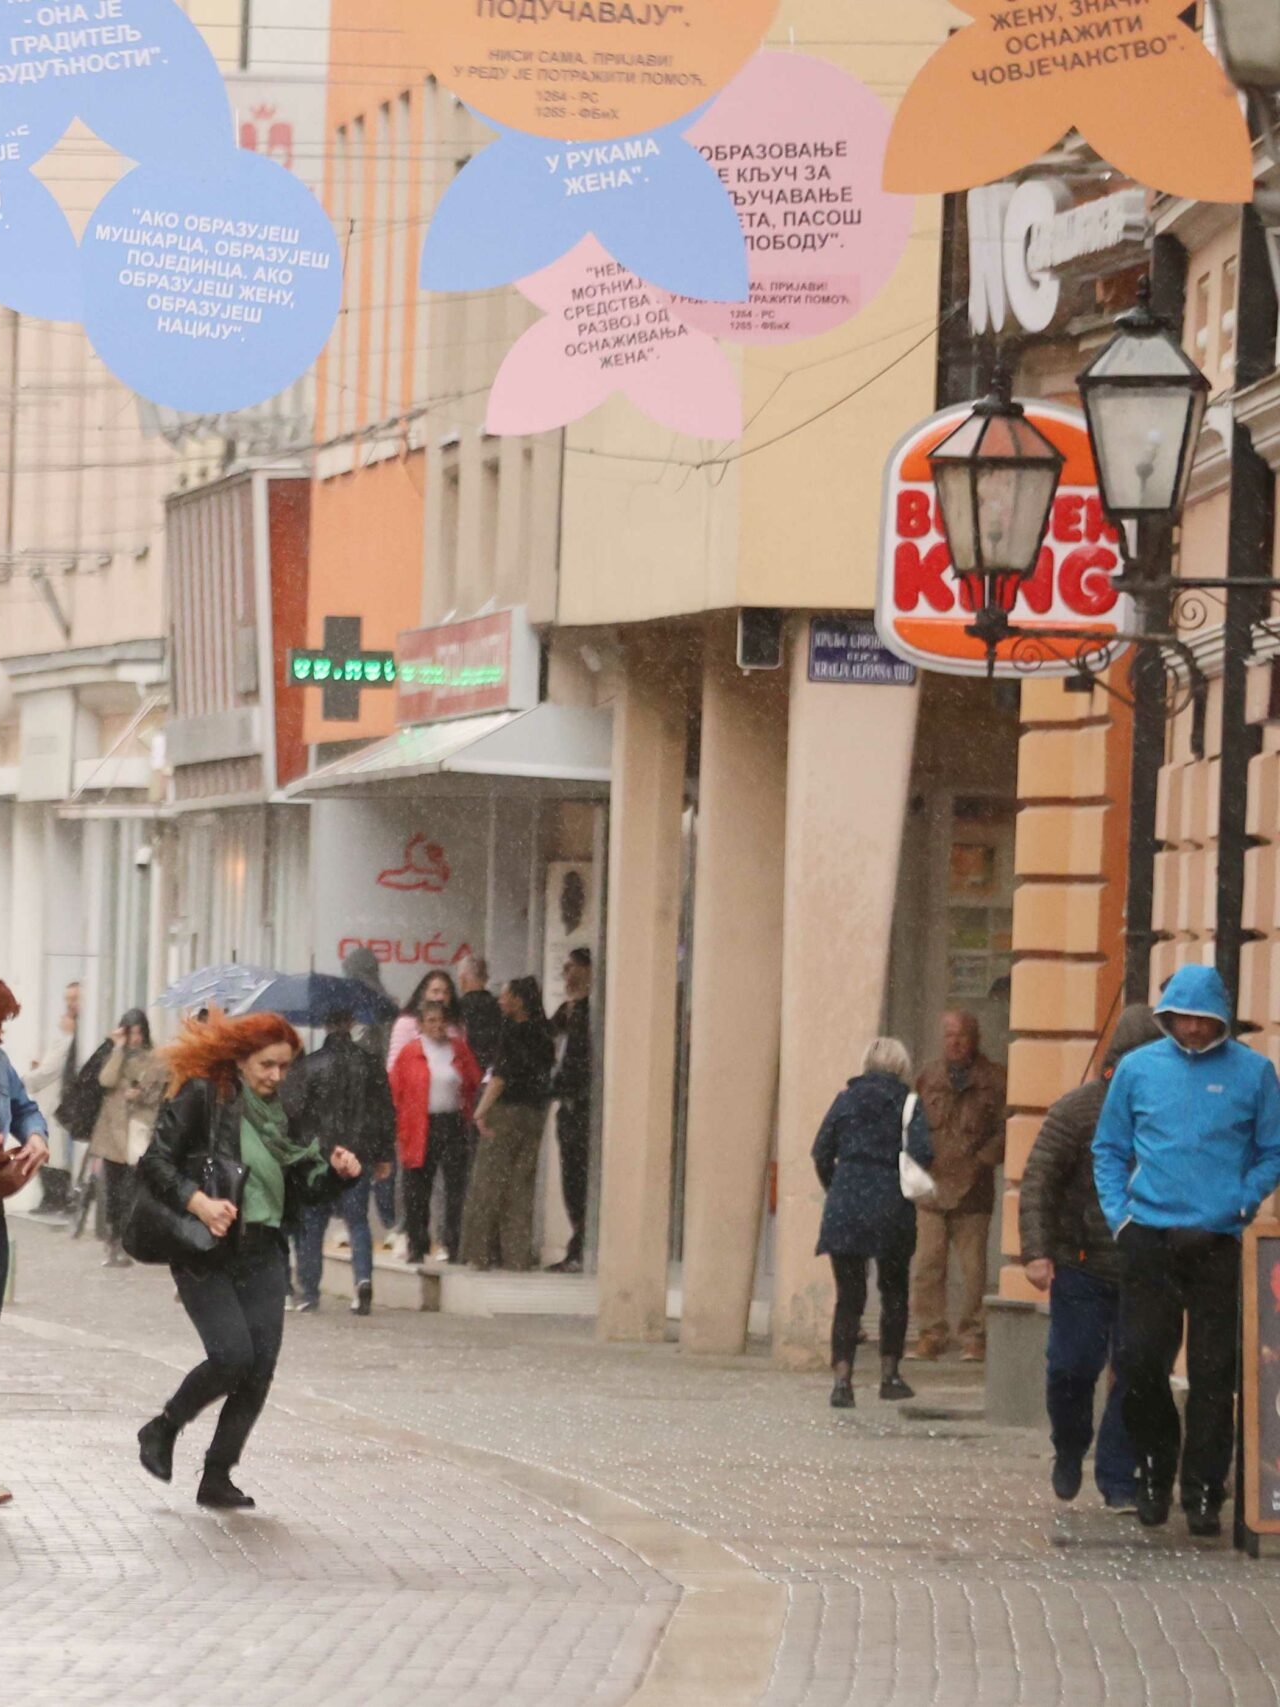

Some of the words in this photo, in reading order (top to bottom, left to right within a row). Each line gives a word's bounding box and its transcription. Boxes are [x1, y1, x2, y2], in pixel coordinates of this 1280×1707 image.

[36, 4, 89, 27] ОНА
[94, 0, 123, 20] ЈЕ
[990, 4, 1063, 32] ЖЕНУ,
[10, 24, 142, 56] ГРАДИТЕЉ
[1005, 15, 1143, 55] ОСНАЖИТИ
[545, 154, 560, 174] У
[565, 137, 660, 171] РУКАМА
[737, 166, 798, 183] КЉУЧ
[804, 165, 831, 181] ЗА
[132, 208, 180, 230] "АКО
[184, 214, 301, 245] ОБРАЗУЈЕШ
[783, 209, 862, 227] ПАСОШ
[95, 223, 210, 257] МУШКАРЦА,
[214, 239, 330, 270] ОБРАЗУЈЕШ
[127, 249, 249, 282] ПОЈЕДИНЦА.
[253, 265, 293, 287] АКО
[118, 269, 234, 300] ОБРАЗУЈЕШ
[239, 284, 296, 310] ЖЕНУ,
[147, 294, 263, 325] ОБРАЗУЈЕШ
[563, 294, 651, 321] СРЕДСТВА
[577, 314, 640, 337] РАЗВОЈ
[645, 309, 670, 324] ОД
[564, 324, 688, 358] ОСНАЖИВАЊА
